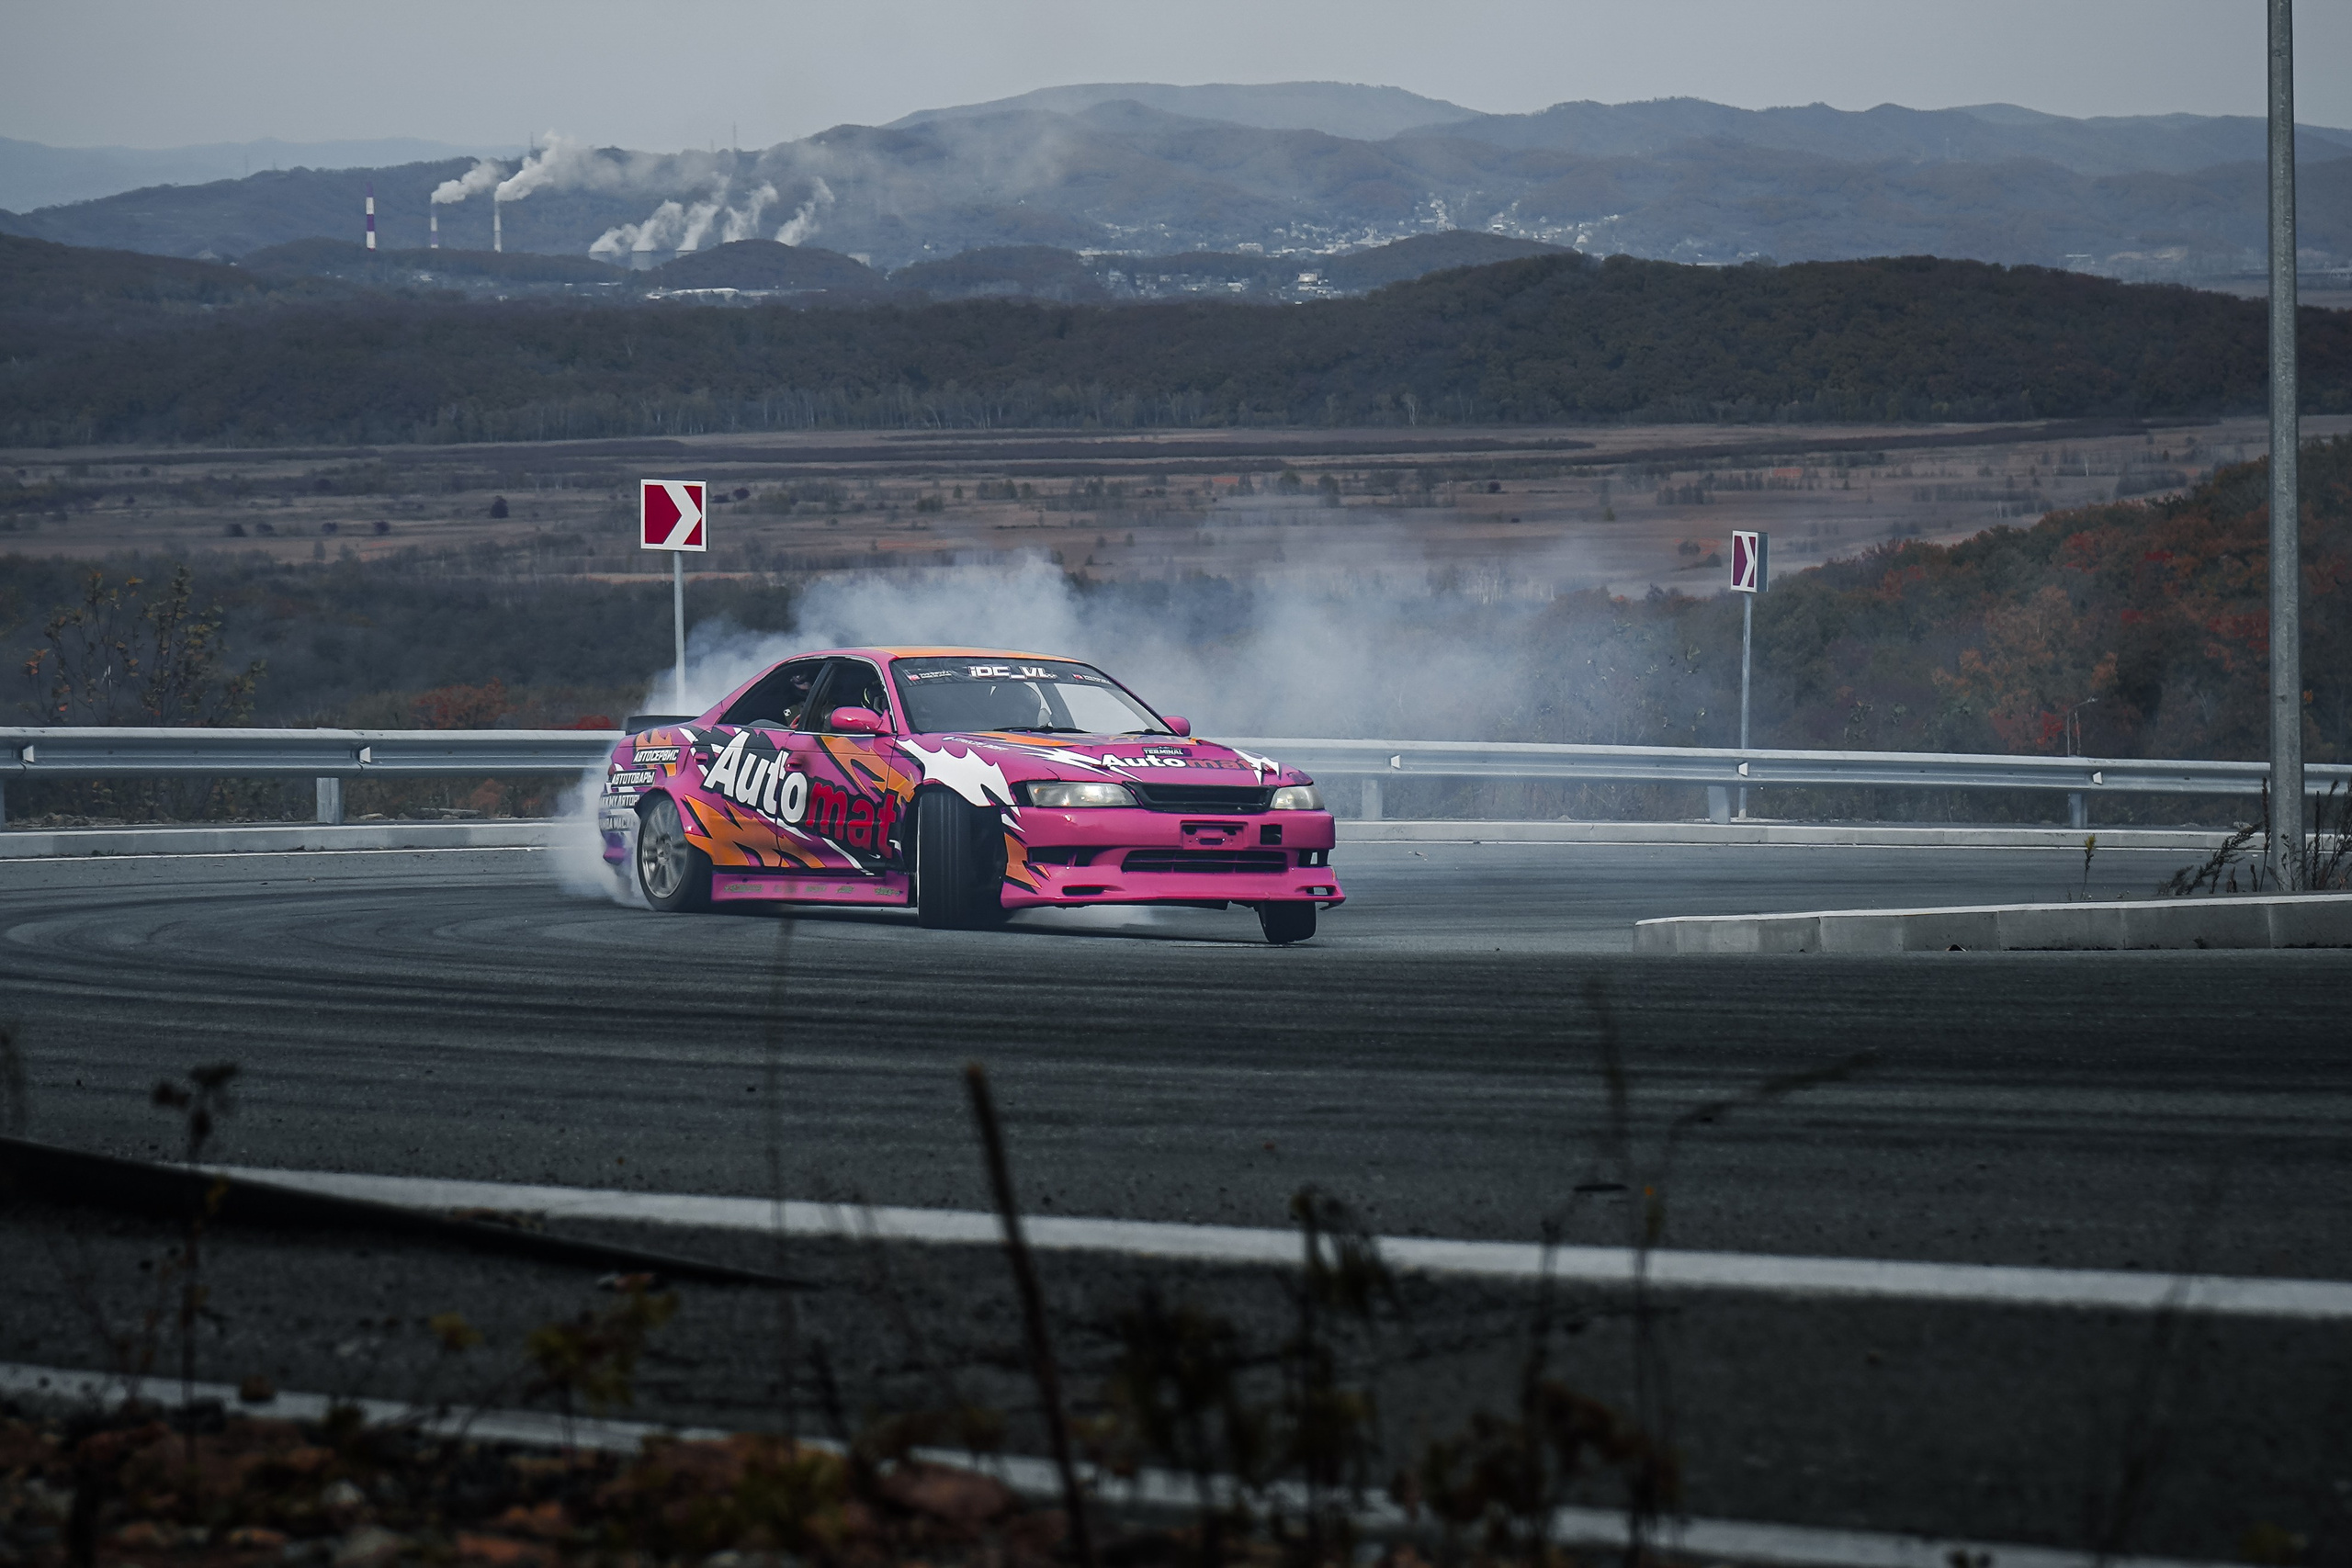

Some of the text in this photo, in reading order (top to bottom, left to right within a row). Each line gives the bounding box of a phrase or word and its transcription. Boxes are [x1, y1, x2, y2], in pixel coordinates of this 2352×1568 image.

[632, 749, 680, 762] АВТОСЕРВИС
[1102, 754, 1258, 771] Automat
[611, 771, 656, 785] АВТОТОВАРЫ
[703, 730, 897, 859] Automat
